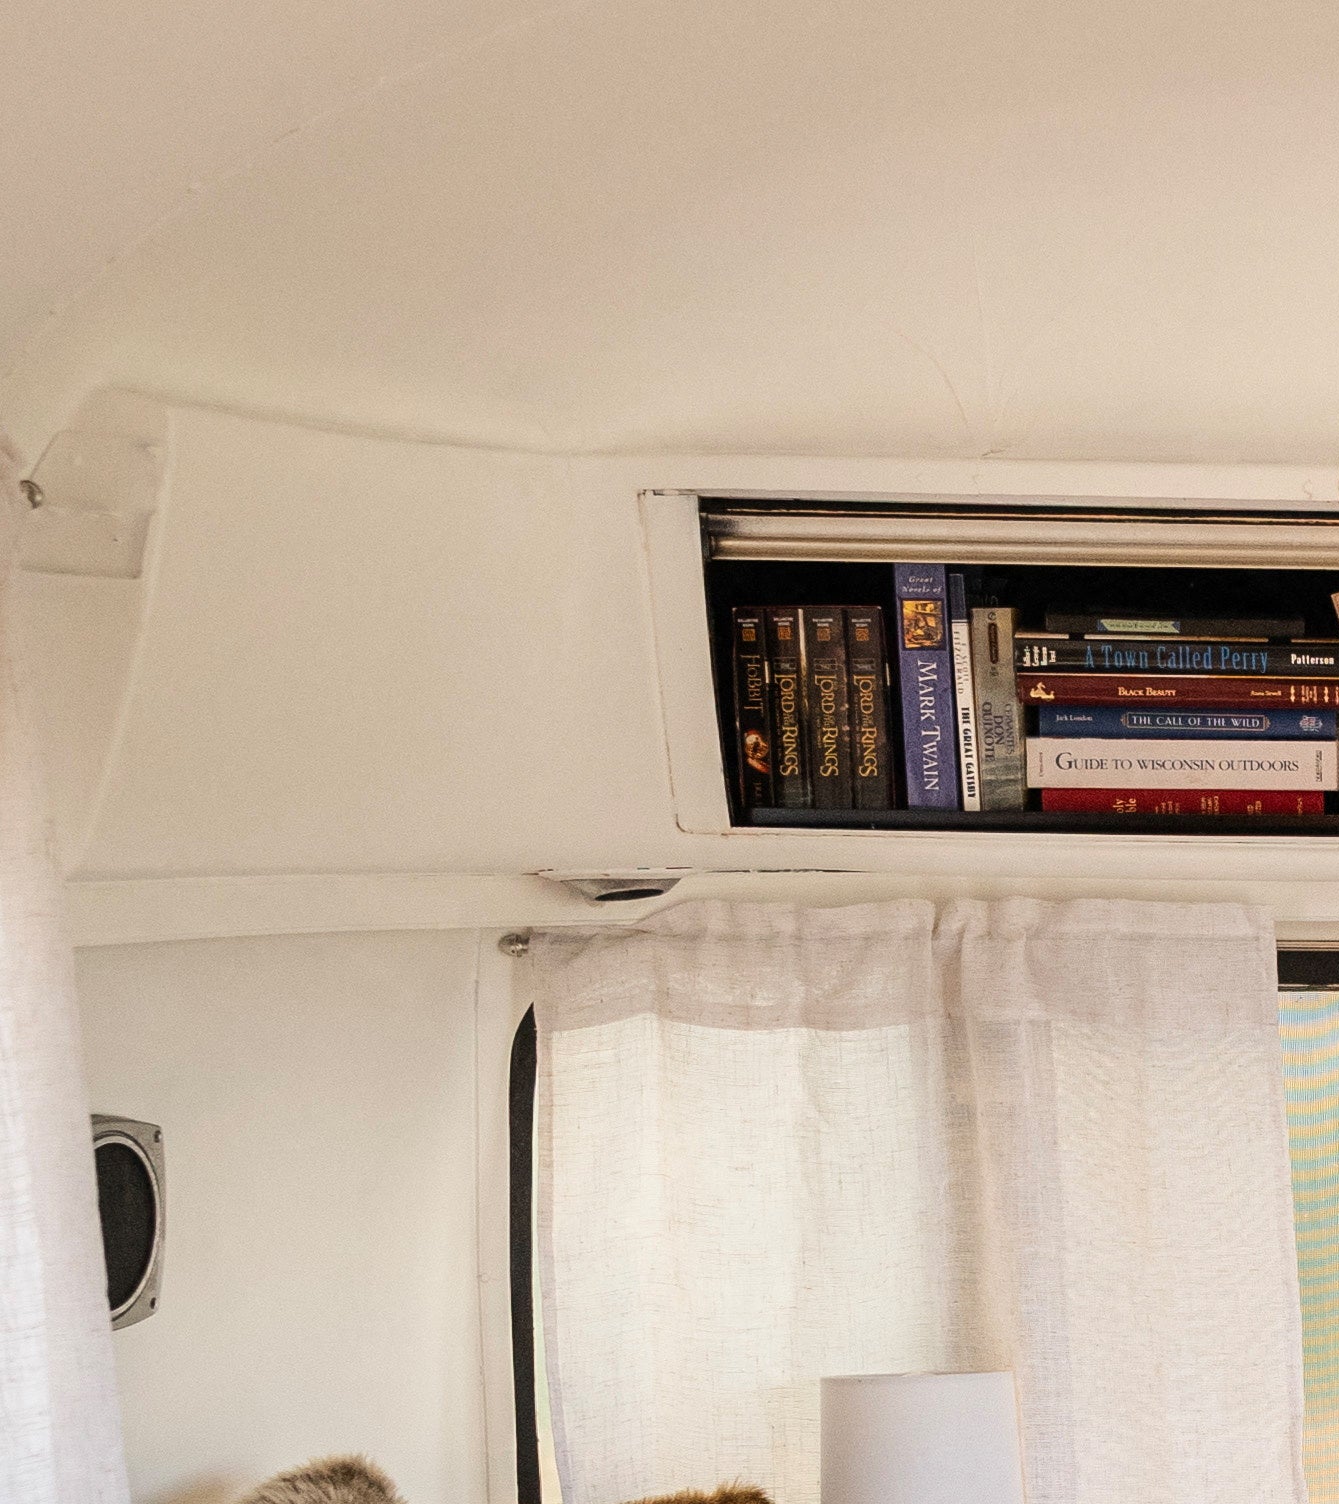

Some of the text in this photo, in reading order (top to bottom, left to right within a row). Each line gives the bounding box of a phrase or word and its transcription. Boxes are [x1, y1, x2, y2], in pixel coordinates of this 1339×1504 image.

[1084, 645, 1095, 668] A
[1100, 645, 1150, 668] Town
[1156, 646, 1213, 670] Called
[1221, 647, 1269, 673] Perry
[1290, 654, 1335, 665] Patterson
[774, 674, 799, 776] LORD RINGS
[814, 674, 839, 777] LORD RINGS
[853, 674, 877, 777] LORD RINGS
[917, 660, 941, 790] MARK TWAIN
[961, 706, 977, 799] THE GREAT GATSBY
[994, 715, 1005, 746] DON
[1131, 716, 1260, 727] THE CALL OF THE WILD
[1055, 752, 1109, 771] GUIDE
[1111, 759, 1133, 770] TO
[1136, 759, 1215, 771] WISCONSIN
[1219, 760, 1299, 772] OUTDOORS
